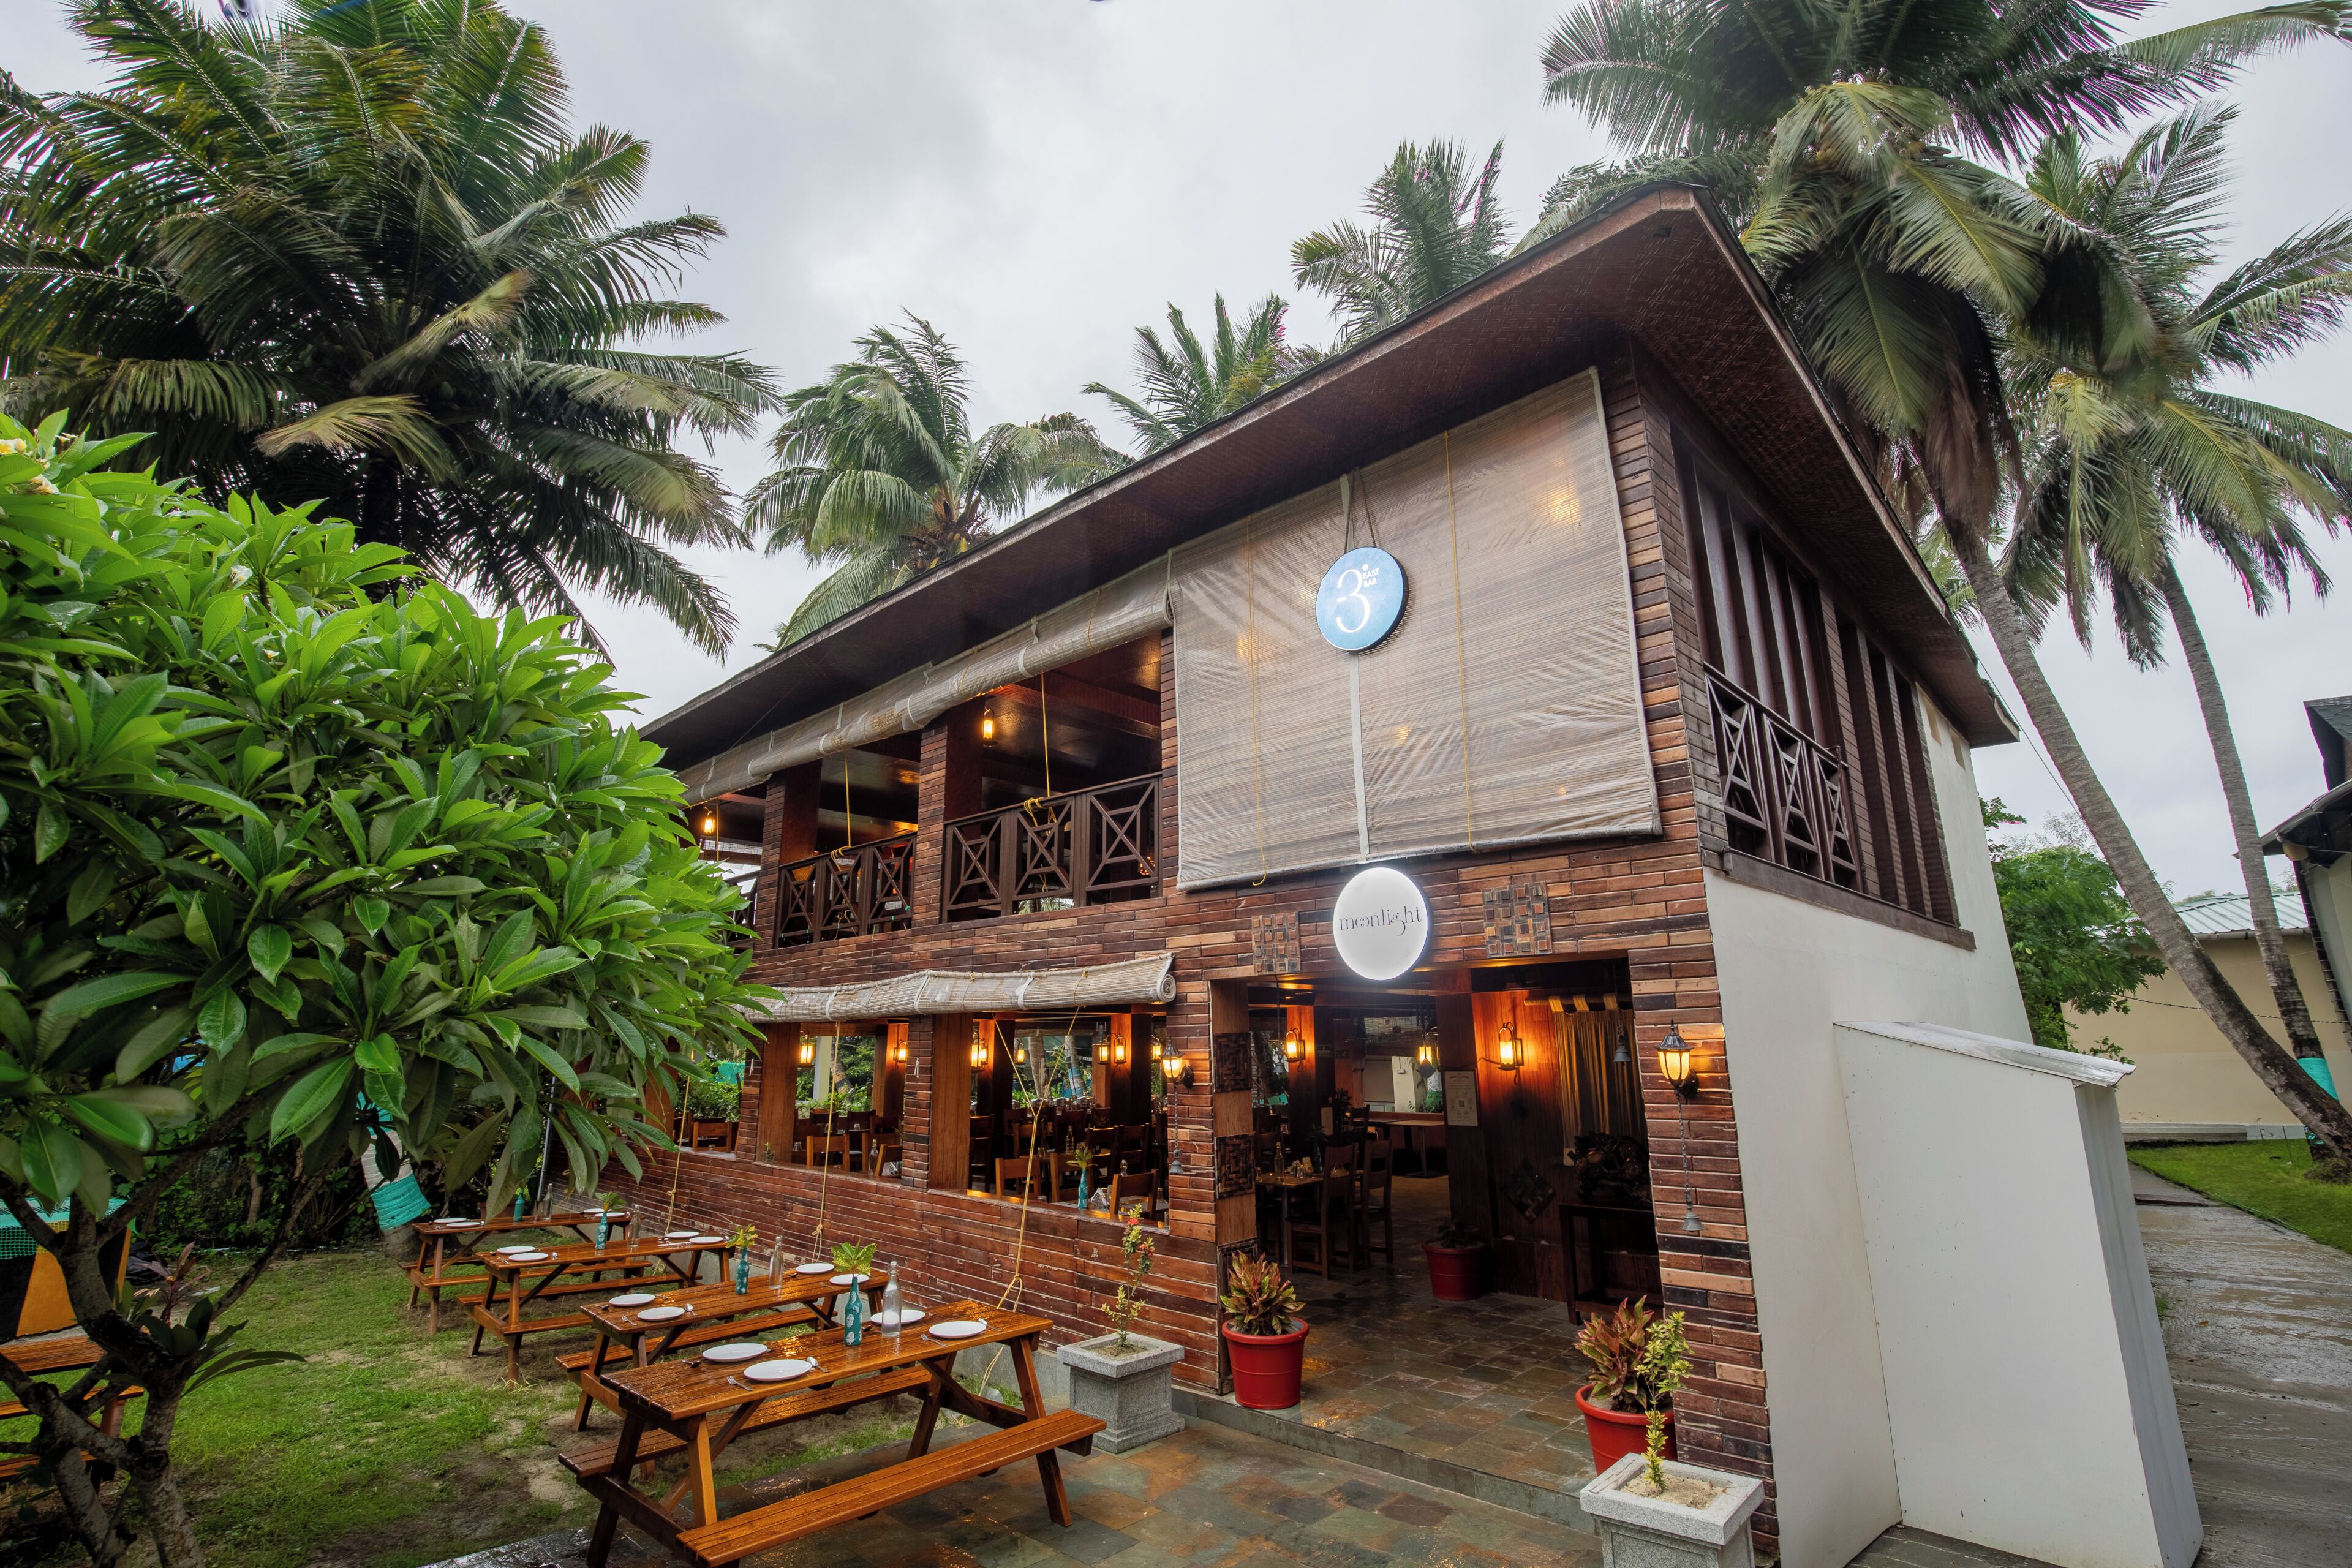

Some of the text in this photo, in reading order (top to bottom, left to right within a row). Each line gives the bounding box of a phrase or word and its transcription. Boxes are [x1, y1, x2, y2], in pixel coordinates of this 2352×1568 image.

[1363, 567, 1379, 579] EAST
[1363, 578, 1378, 588] BAR
[1339, 906, 1422, 936] moonlight
